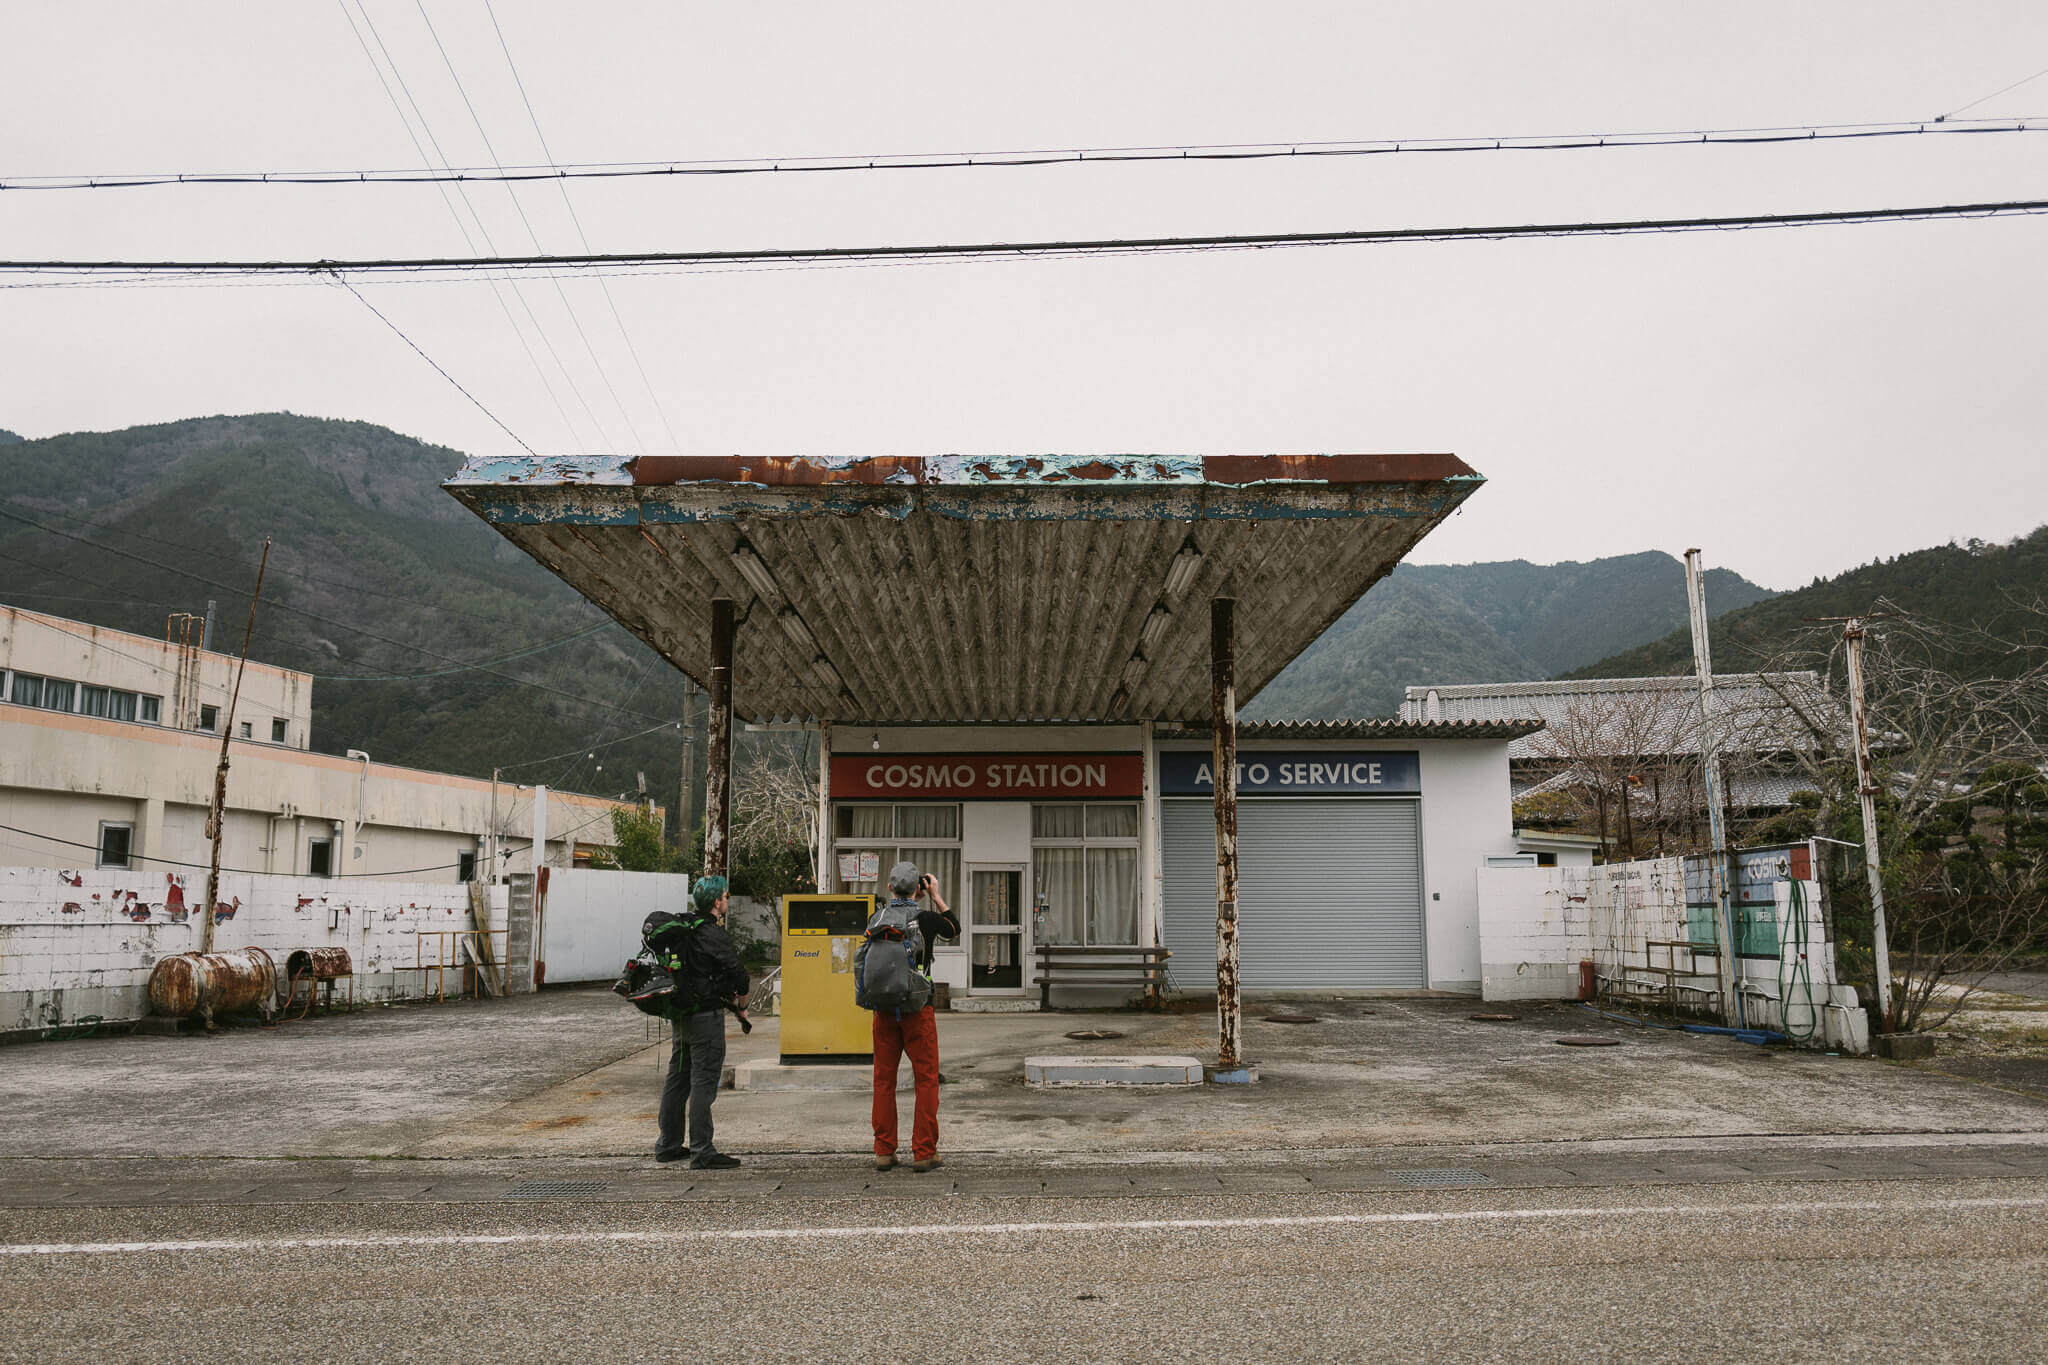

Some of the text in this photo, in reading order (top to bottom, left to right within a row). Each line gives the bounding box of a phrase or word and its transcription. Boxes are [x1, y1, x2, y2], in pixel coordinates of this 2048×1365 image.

[866, 764, 1106, 788] COSMO STATION
[1194, 763, 1382, 785] ATO SERVICE
[1747, 855, 1788, 880] COSMO
[793, 949, 820, 958] Diesel
